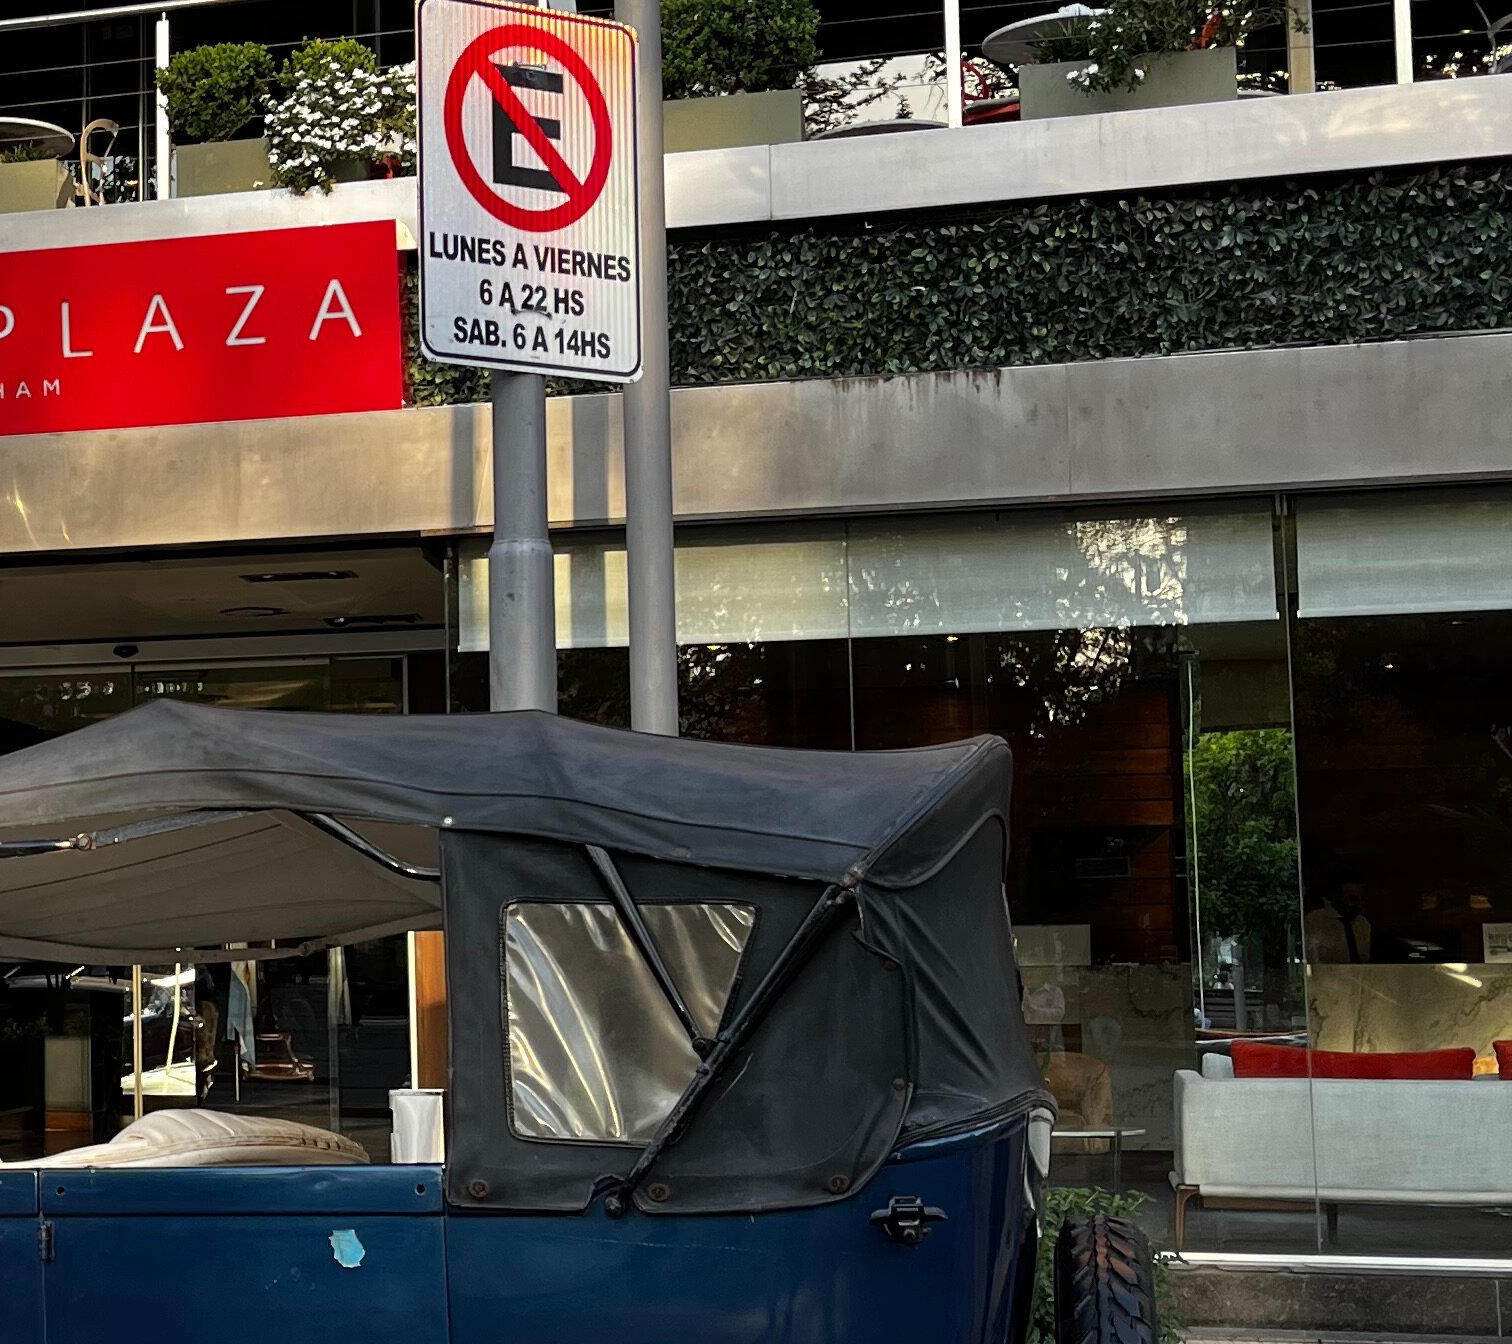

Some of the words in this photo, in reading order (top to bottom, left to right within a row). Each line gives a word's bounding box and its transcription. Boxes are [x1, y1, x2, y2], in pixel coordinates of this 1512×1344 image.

[429, 231, 506, 267] LUNES
[512, 242, 529, 270] A
[533, 245, 631, 283] VIERNES
[479, 278, 493, 306] 6
[499, 281, 516, 309] A
[521, 283, 549, 313] 22
[554, 287, 585, 317] HS
[453, 316, 507, 348] SAB.
[513, 323, 527, 350] 6
[531, 326, 549, 353] A
